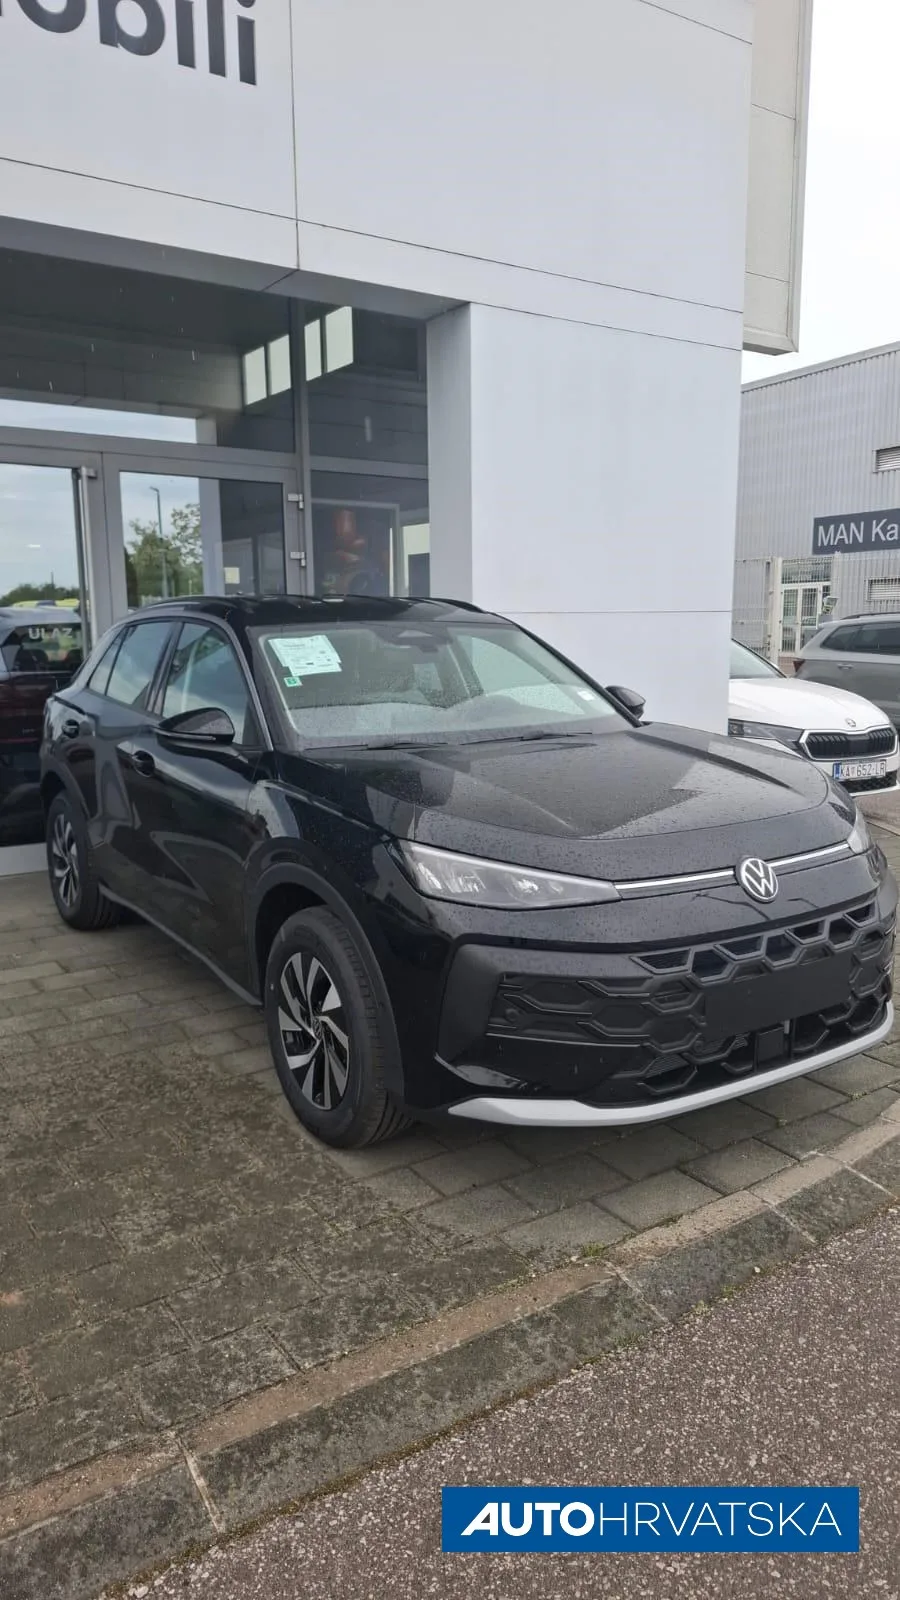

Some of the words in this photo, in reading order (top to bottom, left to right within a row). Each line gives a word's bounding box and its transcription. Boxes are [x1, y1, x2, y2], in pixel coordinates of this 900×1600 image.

[0, 0, 257, 86] obili
[817, 521, 865, 547] MAN
[871, 518, 899, 542] Ka
[28, 627, 73, 640] ULAZ
[741, 858, 778, 900] VW
